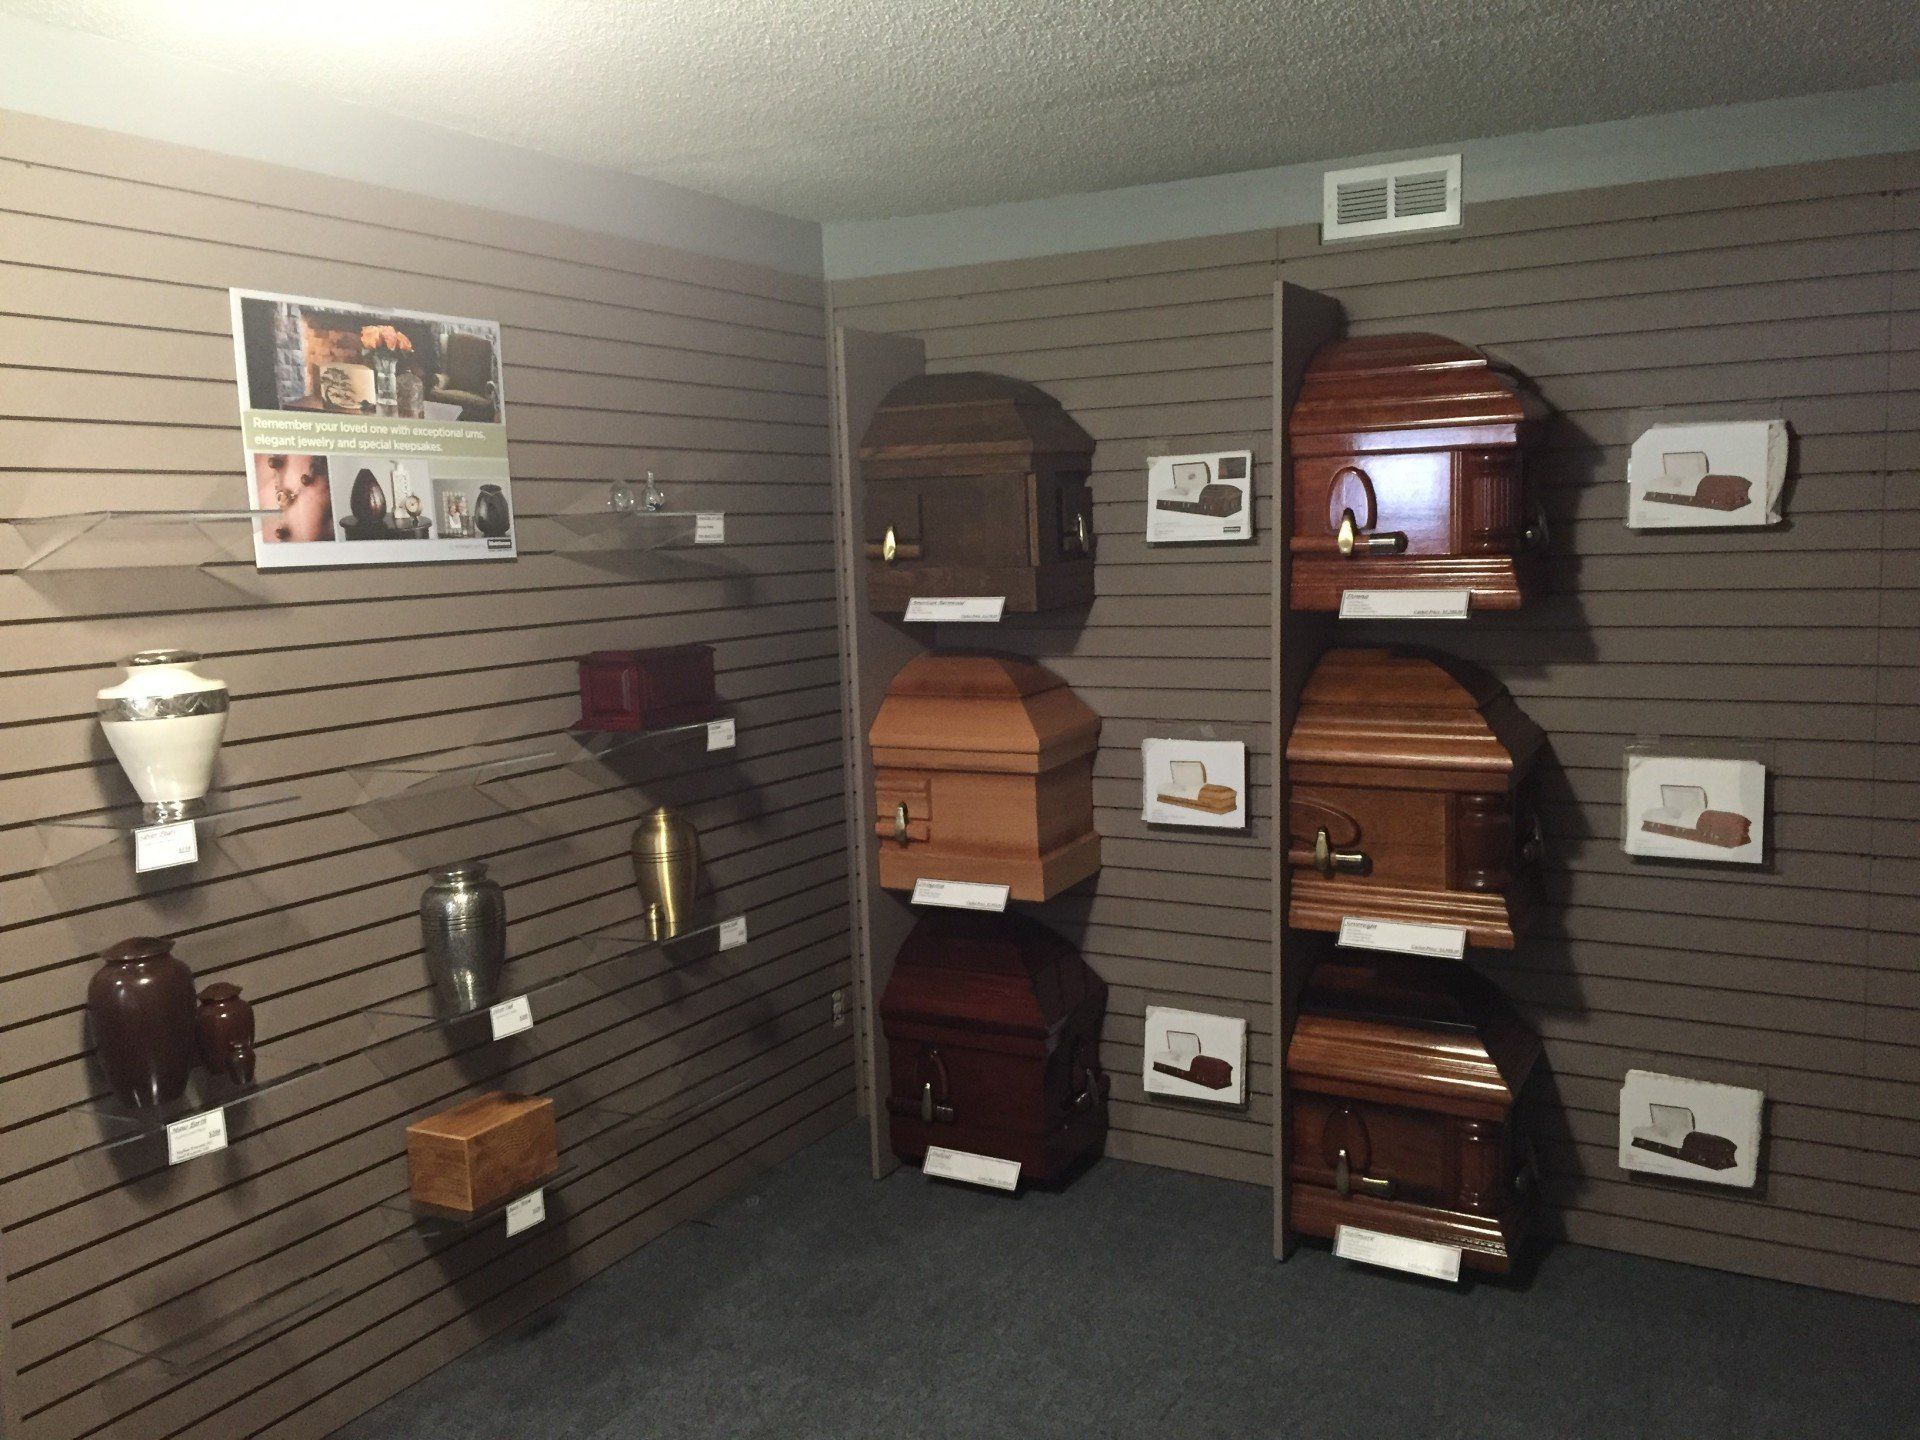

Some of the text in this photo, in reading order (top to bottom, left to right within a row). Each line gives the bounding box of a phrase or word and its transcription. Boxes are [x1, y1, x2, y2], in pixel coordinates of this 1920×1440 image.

[252, 416, 487, 441] Remember your loved one with exceptional urns,
[254, 434, 444, 452] elegant jewelry and special keepsakes.
